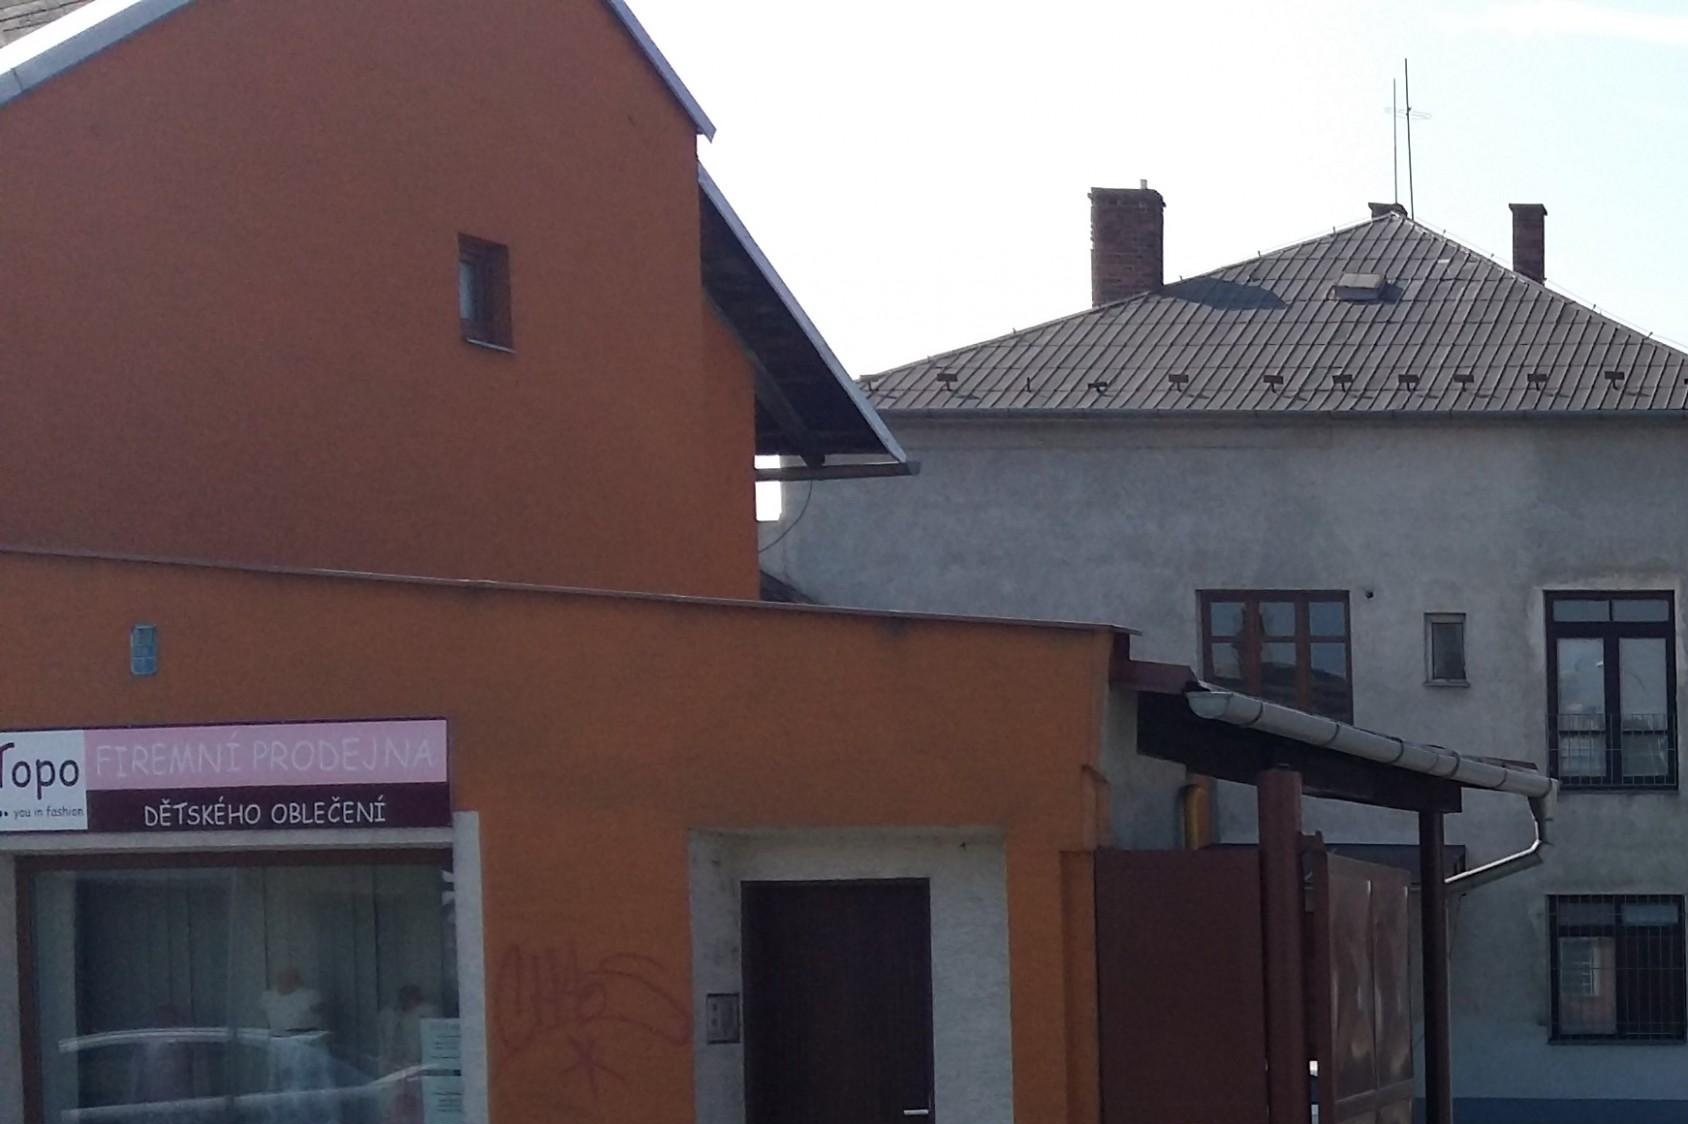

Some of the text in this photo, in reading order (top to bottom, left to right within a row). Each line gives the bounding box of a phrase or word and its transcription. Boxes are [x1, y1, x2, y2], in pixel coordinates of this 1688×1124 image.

[96, 730, 434, 777] FIREMNÍ PRODEJNA
[46, 805, 84, 818] fashion
[144, 795, 387, 826] DĚTSKÉHO OBLEČENÍ
